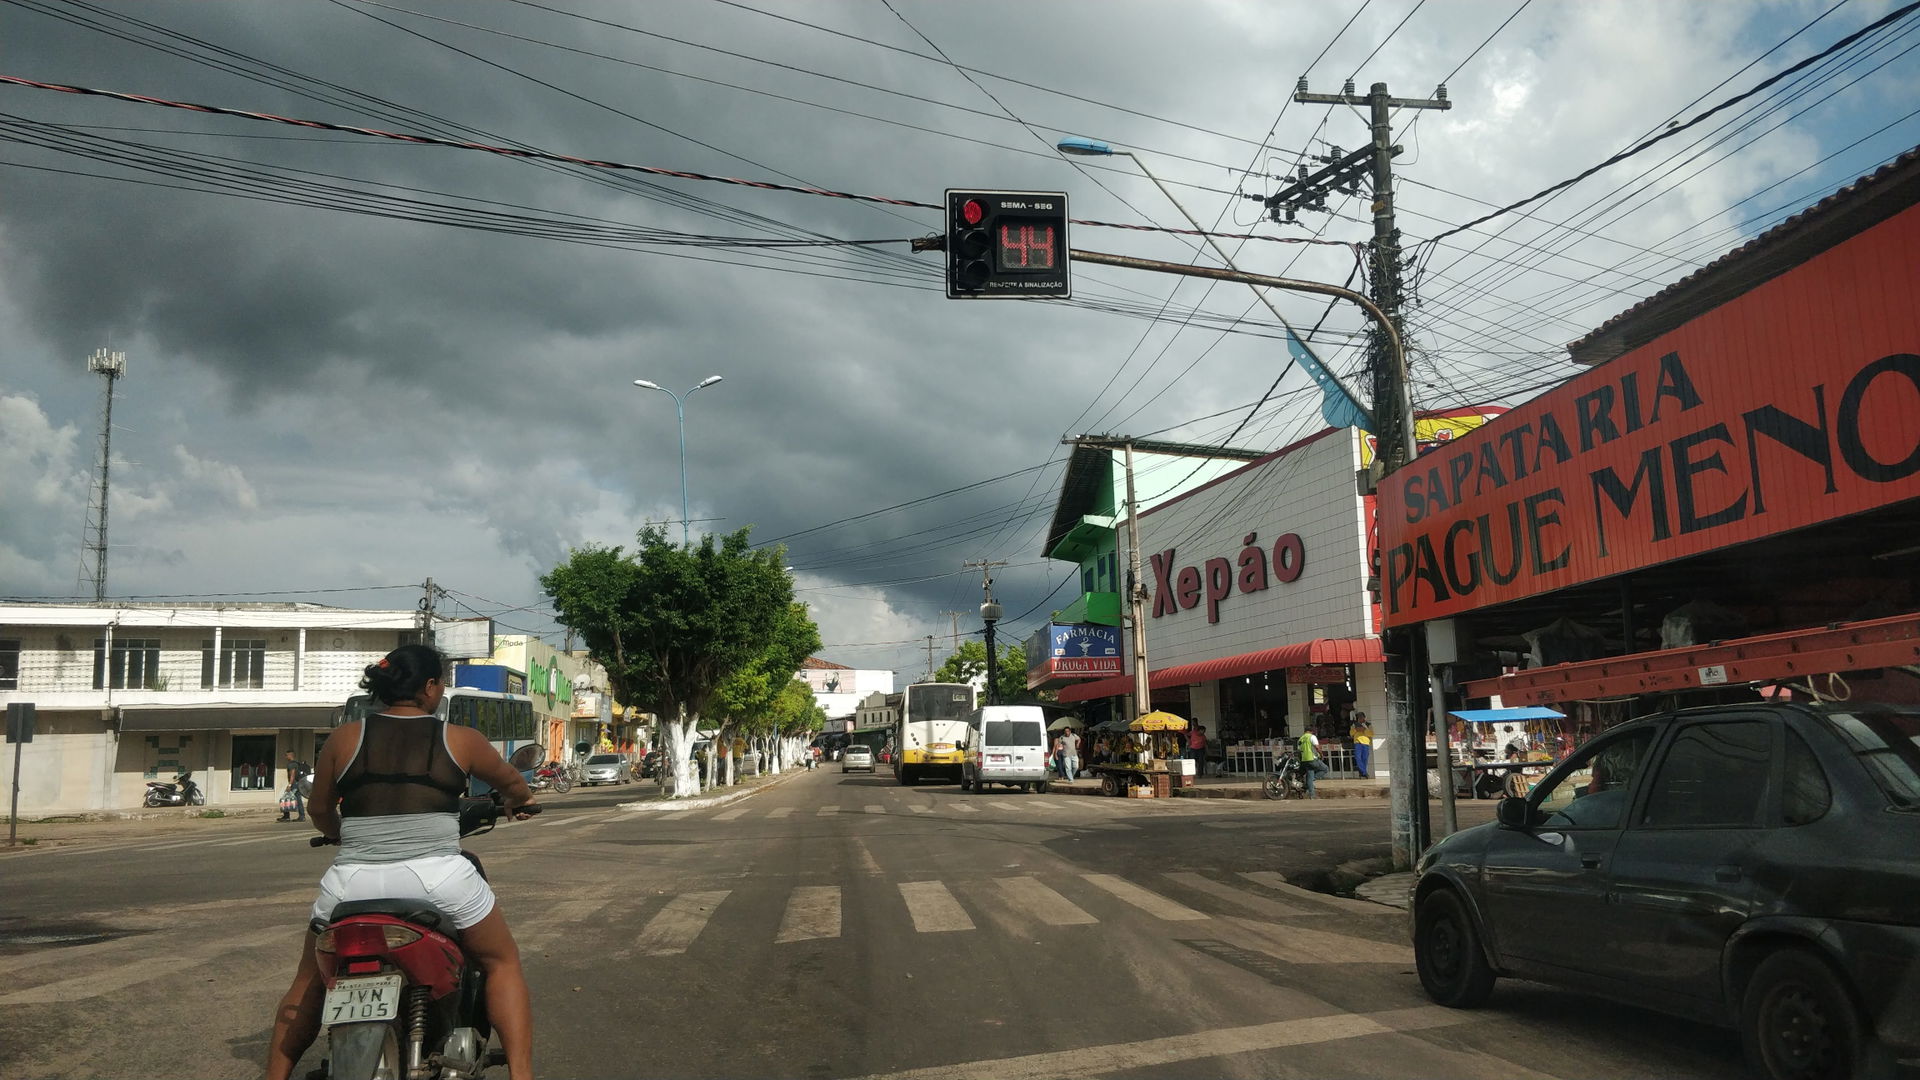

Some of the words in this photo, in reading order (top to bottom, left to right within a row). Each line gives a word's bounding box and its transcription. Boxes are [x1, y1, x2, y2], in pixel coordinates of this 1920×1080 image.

[1001, 201, 1026, 209] SEMA
[1001, 224, 1054, 267] 44
[1024, 281, 1063, 289] SINALIZAÇÃO
[1404, 350, 1705, 525] SAPATARIA
[1387, 487, 1573, 615] PAGUE
[1149, 531, 1306, 624] Xepão
[1055, 626, 1115, 645] FARMÁCIA
[1054, 660, 1089, 671] DROGA
[1092, 659, 1118, 670] VIDA
[341, 988, 383, 1005] JVN
[332, 1003, 388, 1020] 7105
